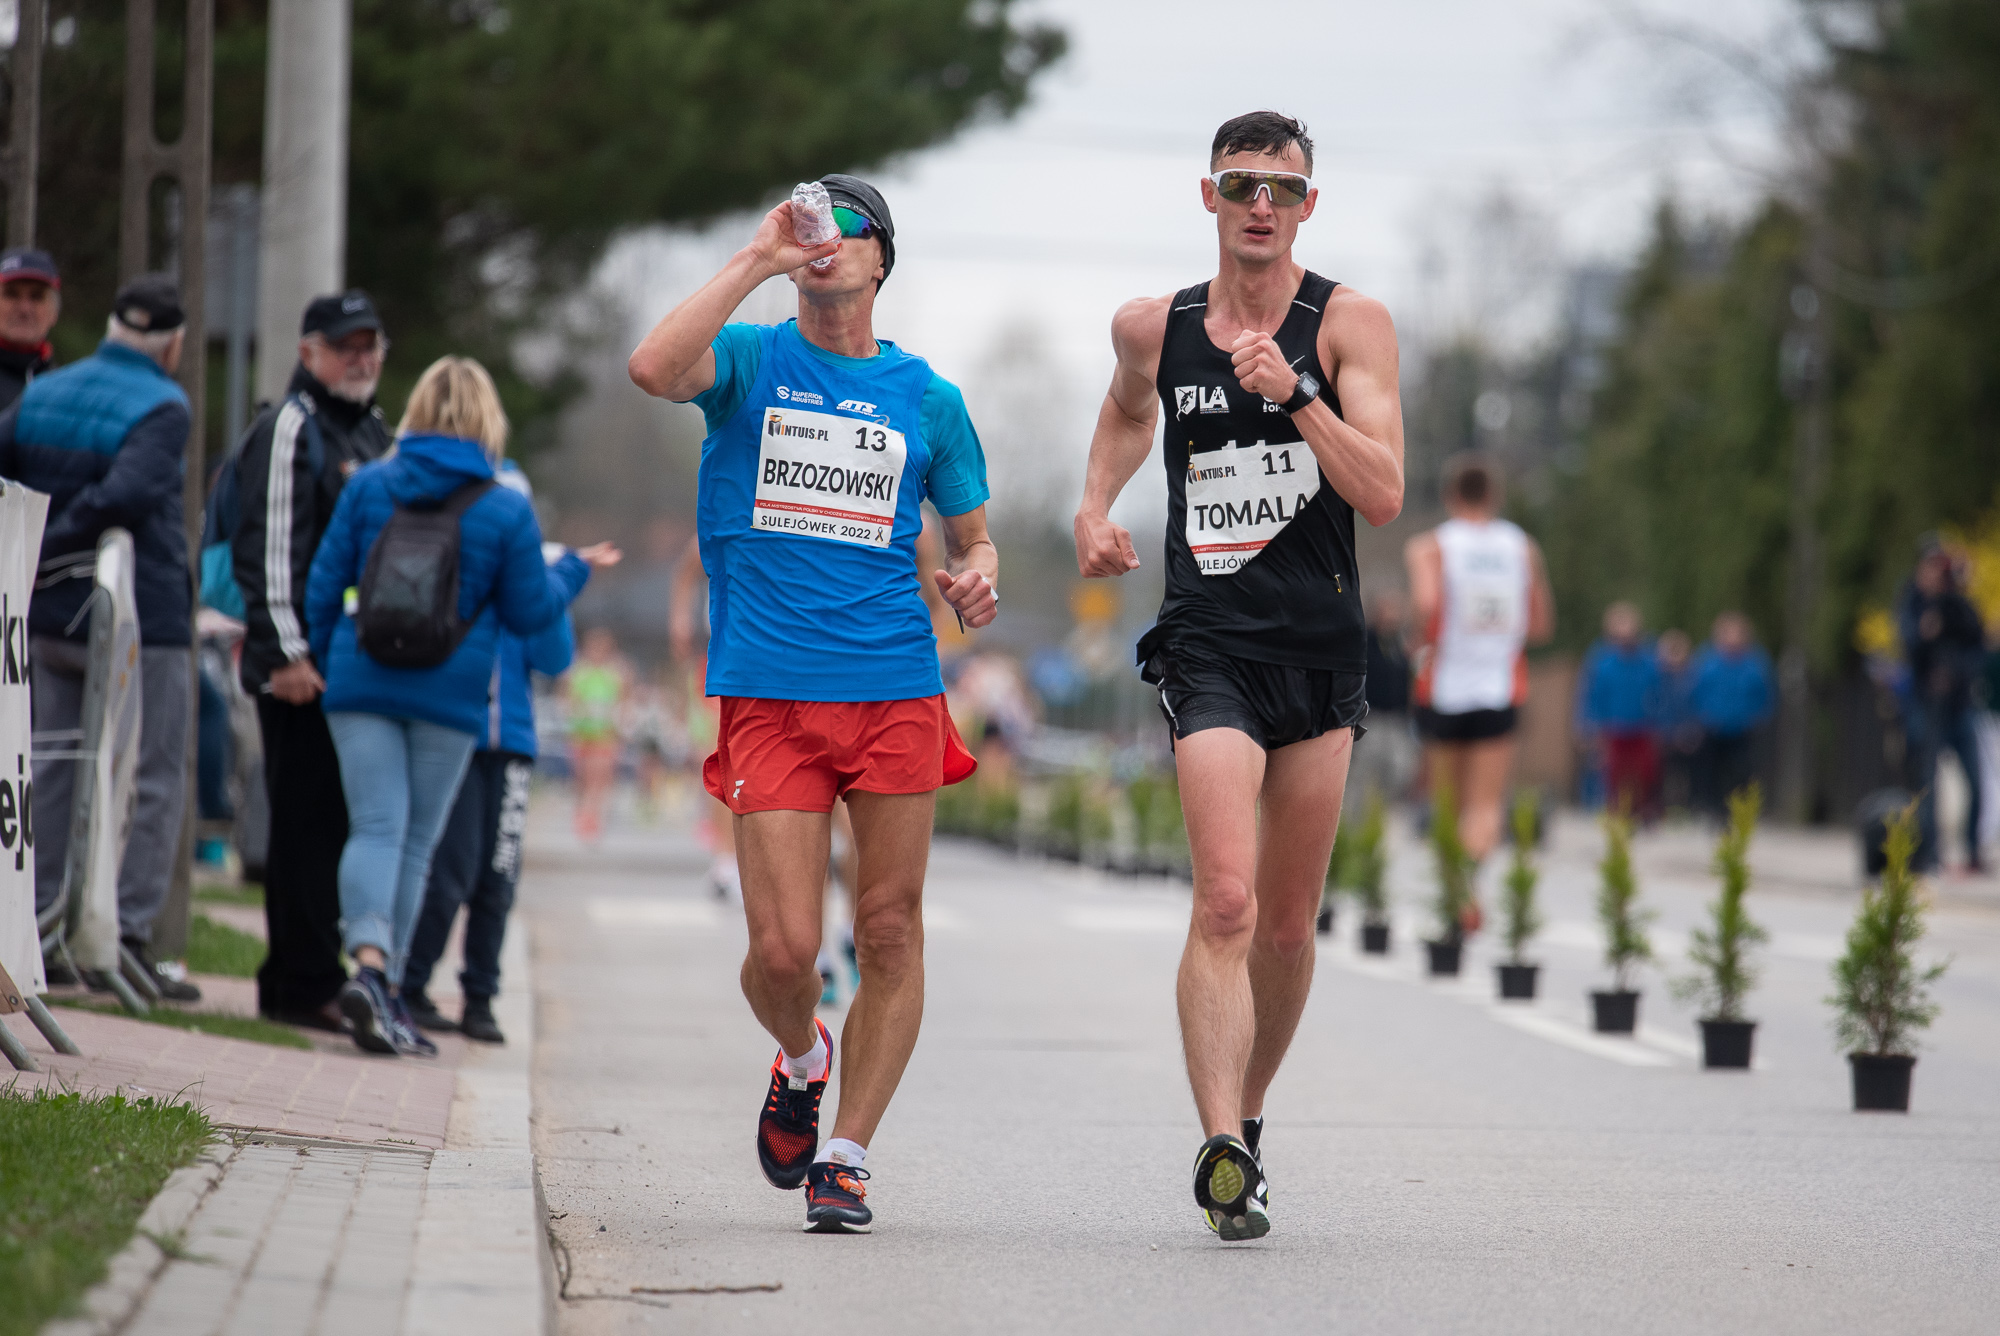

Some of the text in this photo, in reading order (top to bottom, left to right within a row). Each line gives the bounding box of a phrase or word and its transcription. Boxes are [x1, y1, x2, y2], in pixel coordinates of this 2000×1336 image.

[791, 396, 823, 406] INDUSTRIES
[792, 391, 823, 401] SUPERIOR
[837, 399, 878, 414] ATS
[781, 424, 829, 442] INTUIS.PL
[855, 427, 887, 452] 13
[1261, 450, 1295, 476] 11
[763, 458, 894, 502] BRZOZOWSKI
[1196, 465, 1237, 482] INTUIS.PL
[1194, 492, 1310, 531] TOMALA
[761, 516, 871, 540] SULEJÓWEK 2022
[1198, 555, 1253, 571] ULEJÓW
